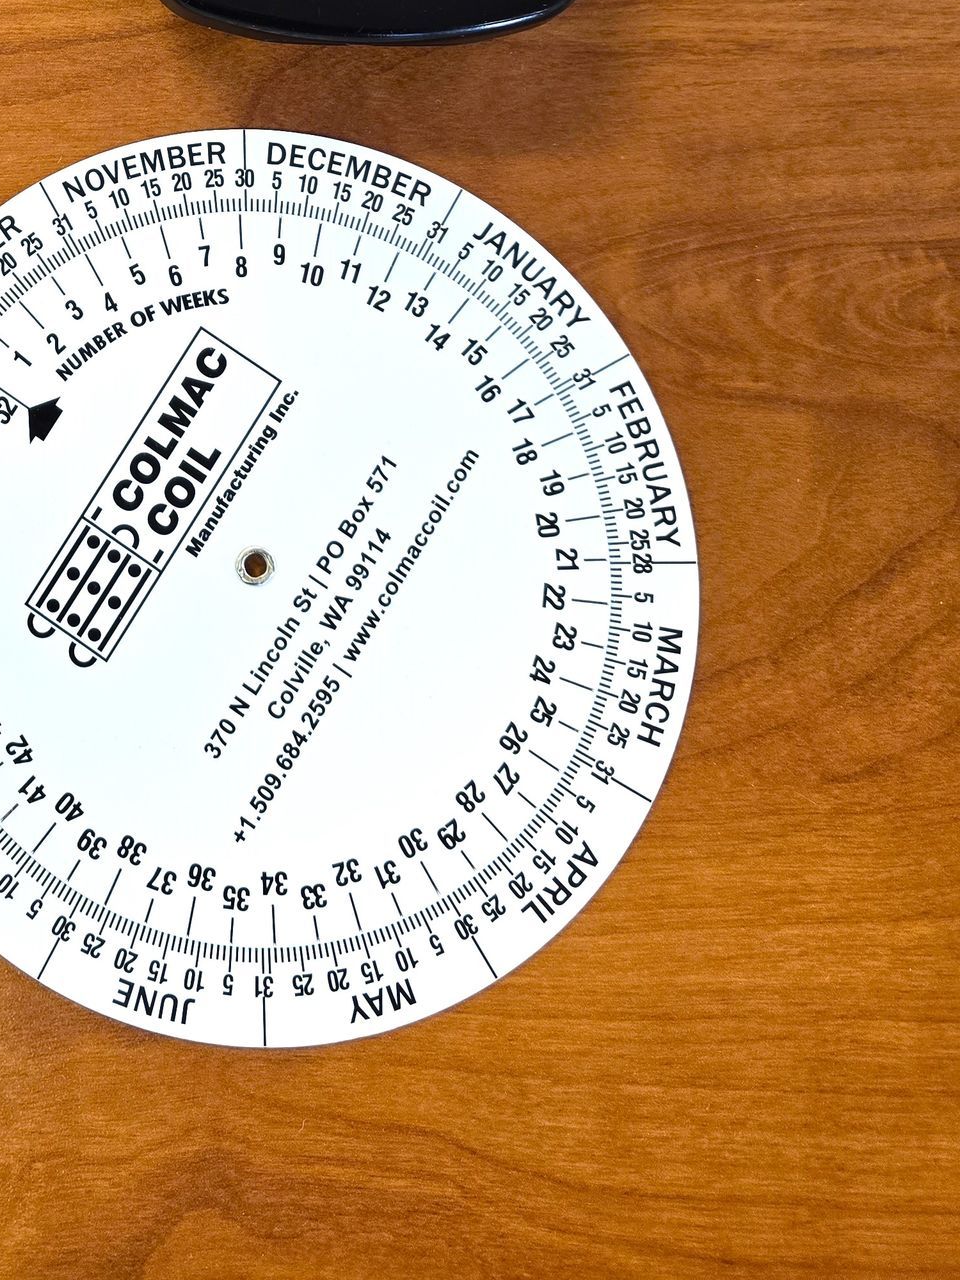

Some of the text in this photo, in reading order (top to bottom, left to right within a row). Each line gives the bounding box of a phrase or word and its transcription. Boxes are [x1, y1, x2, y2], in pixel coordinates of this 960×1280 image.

[62, 141, 226, 203] NOVEMBER
[172, 172, 191, 192] 20
[204, 169, 224, 188] 25
[268, 141, 432, 206] DECEMBER
[299, 175, 317, 194] 10
[109, 188, 129, 208] 10
[141, 178, 161, 198] 15
[84, 200, 97, 219] 5
[199, 245, 210, 266] 7
[236, 256, 247, 277] 8
[274, 244, 285, 265] 9
[129, 264, 145, 285] 5
[169, 265, 182, 286] 6
[301, 263, 324, 286] 10
[472, 222, 591, 327] JANUARY
[367, 286, 391, 312] 12
[47, 333, 66, 355] 2
[56, 289, 229, 381] NUMBER OF WEEKS
[113, 347, 228, 511] COLMAC
[185, 391, 298, 558] Manufacturing Inc.
[609, 380, 681, 549] FEBRUARY
[147, 448, 221, 536] COIL
[204, 456, 396, 758] 370 N Lincoln St PO Box 571
[543, 583, 565, 610] 22
[267, 528, 391, 720] Colville, WA 99114
[233, 448, 479, 843] +1.509.684.2595 www.colmaccoil.com
[530, 655, 555, 684] 24
[637, 626, 683, 747] MARCH
[55, 793, 84, 821] 40
[117, 835, 146, 865] 38
[398, 828, 428, 858] 30
[332, 859, 362, 886] 32
[521, 841, 598, 923] APRIL
[361, 960, 383, 984] 15
[113, 978, 195, 1024] JUNE
[351, 979, 416, 1023] MAY
